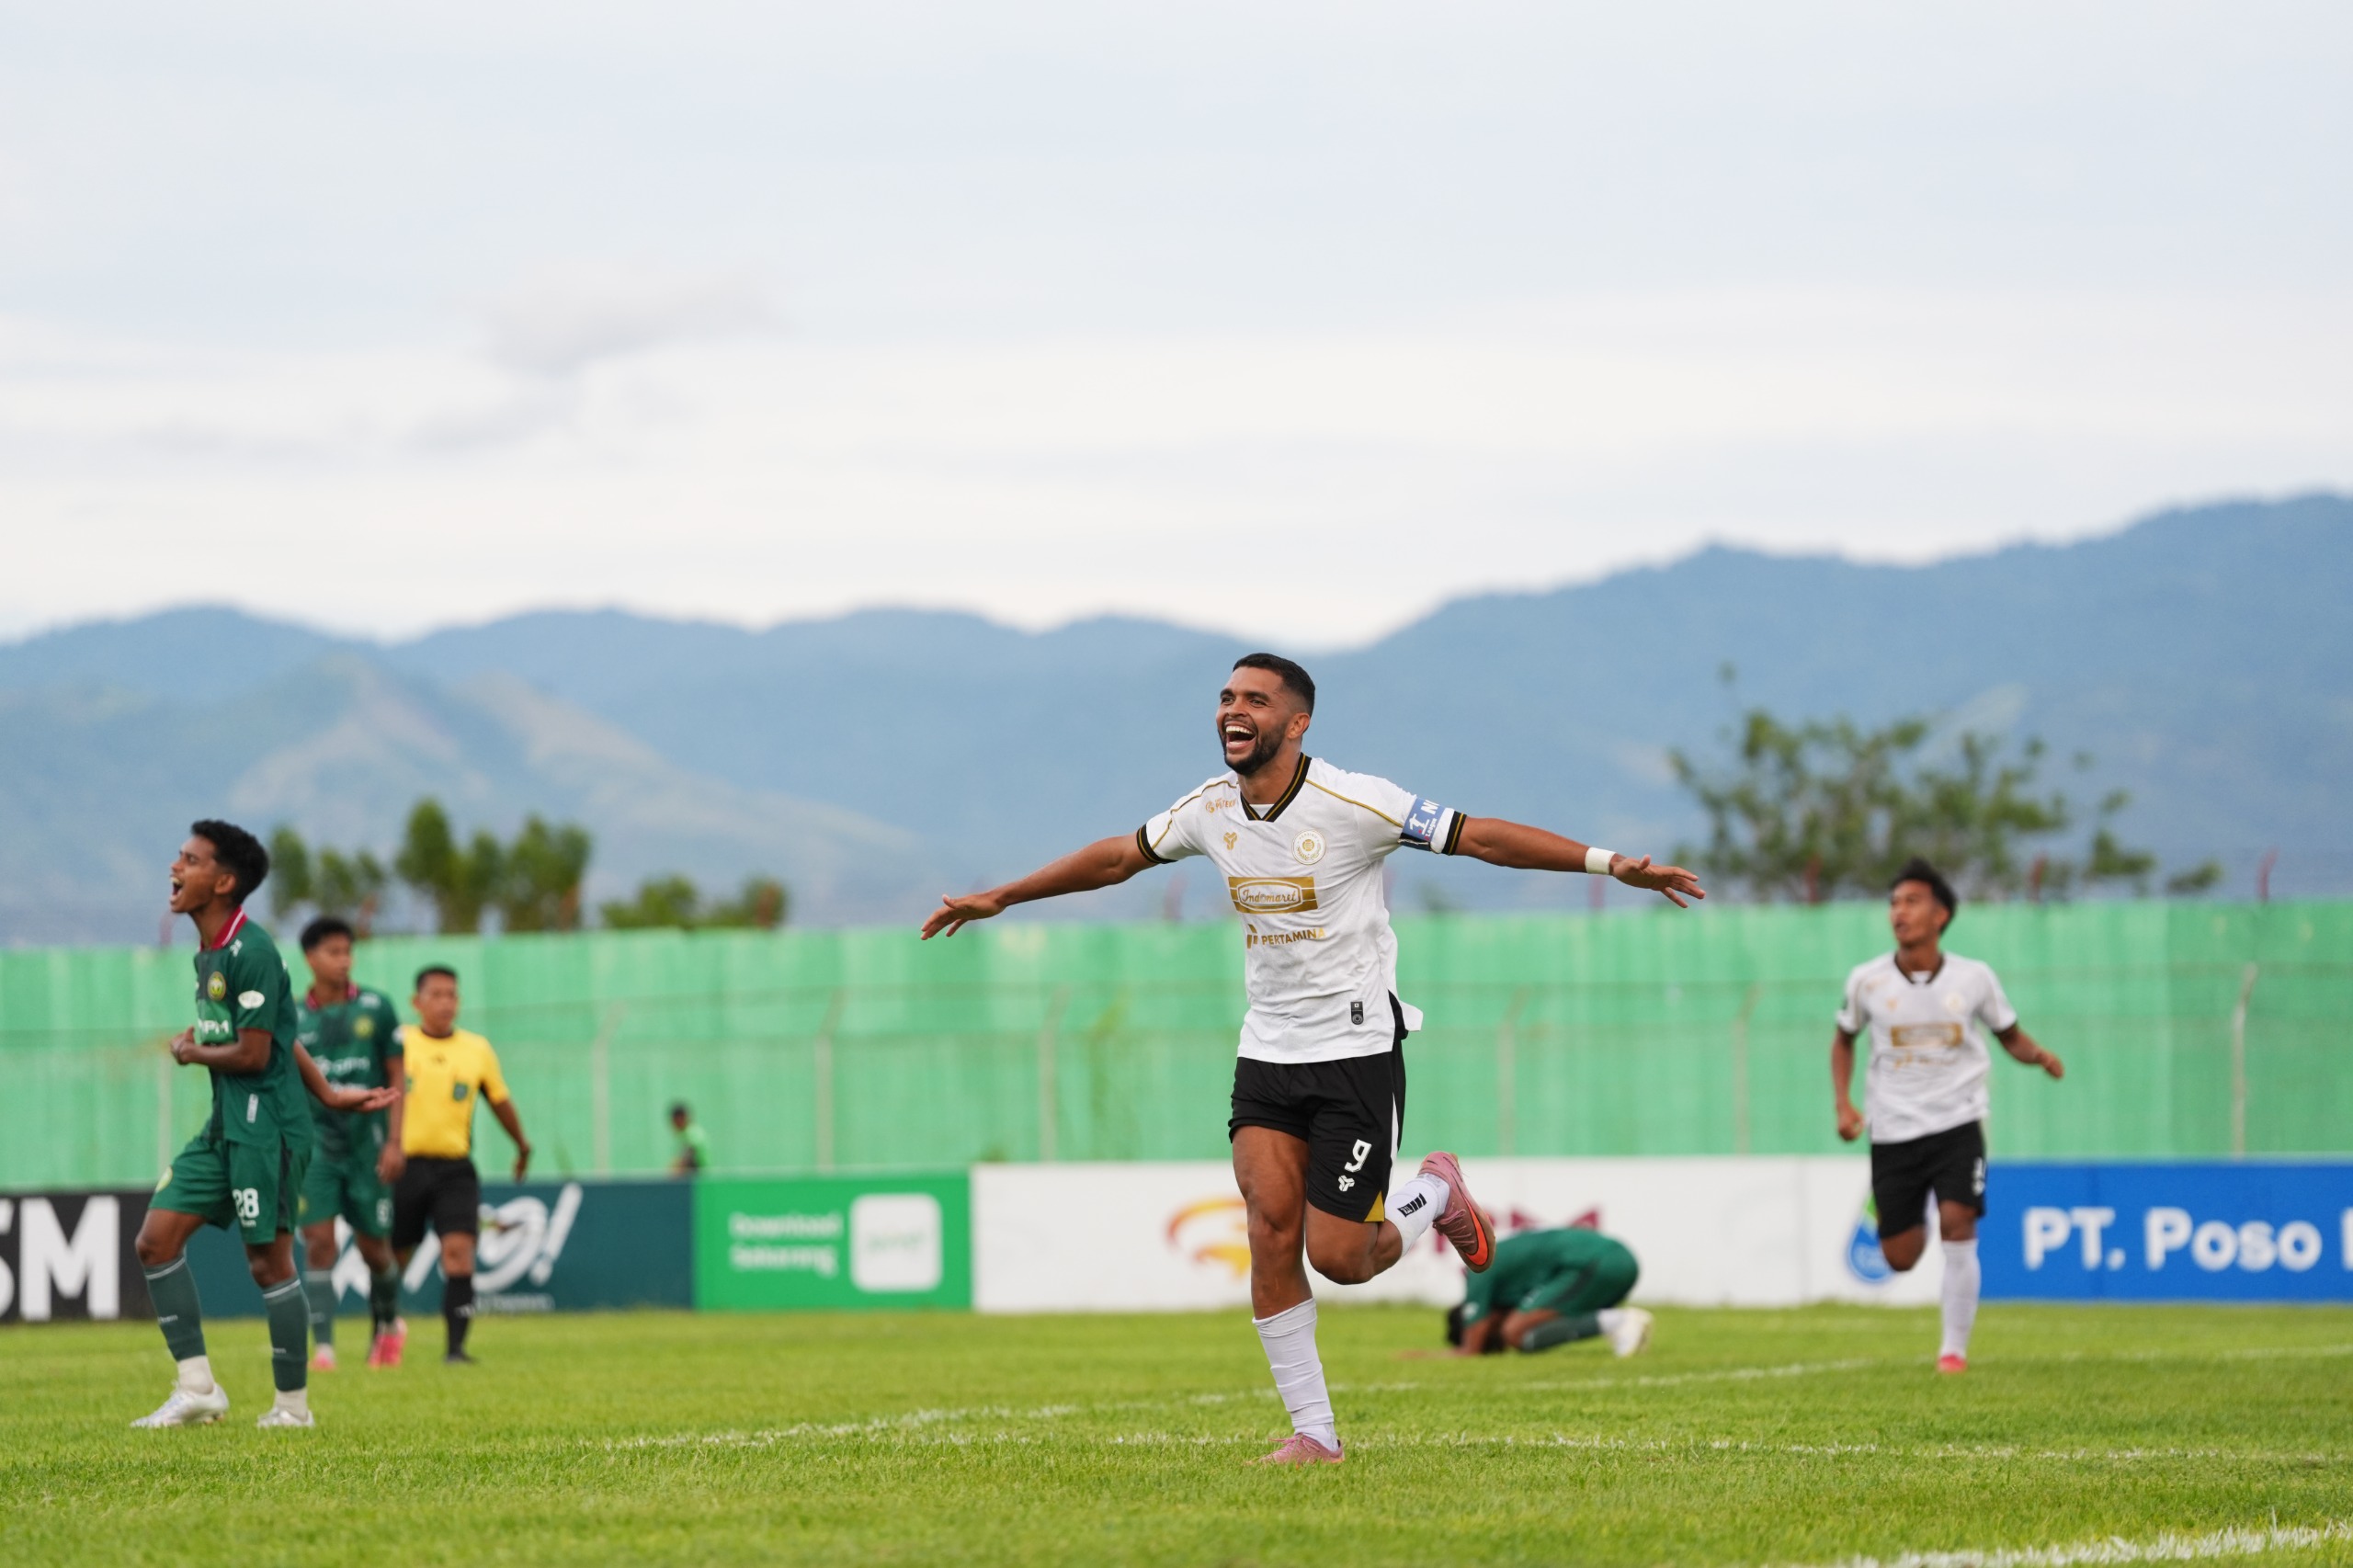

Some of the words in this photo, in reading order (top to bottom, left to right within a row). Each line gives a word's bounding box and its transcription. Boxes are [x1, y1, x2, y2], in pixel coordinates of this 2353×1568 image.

[1243, 889, 1297, 903] Indomaret
[1261, 927, 1326, 946] PERTAMINA
[1344, 1139, 1372, 1173] 9
[232, 1188, 260, 1219] 28
[2023, 1207, 2126, 1271] PT.
[2144, 1207, 2323, 1272] Poso
